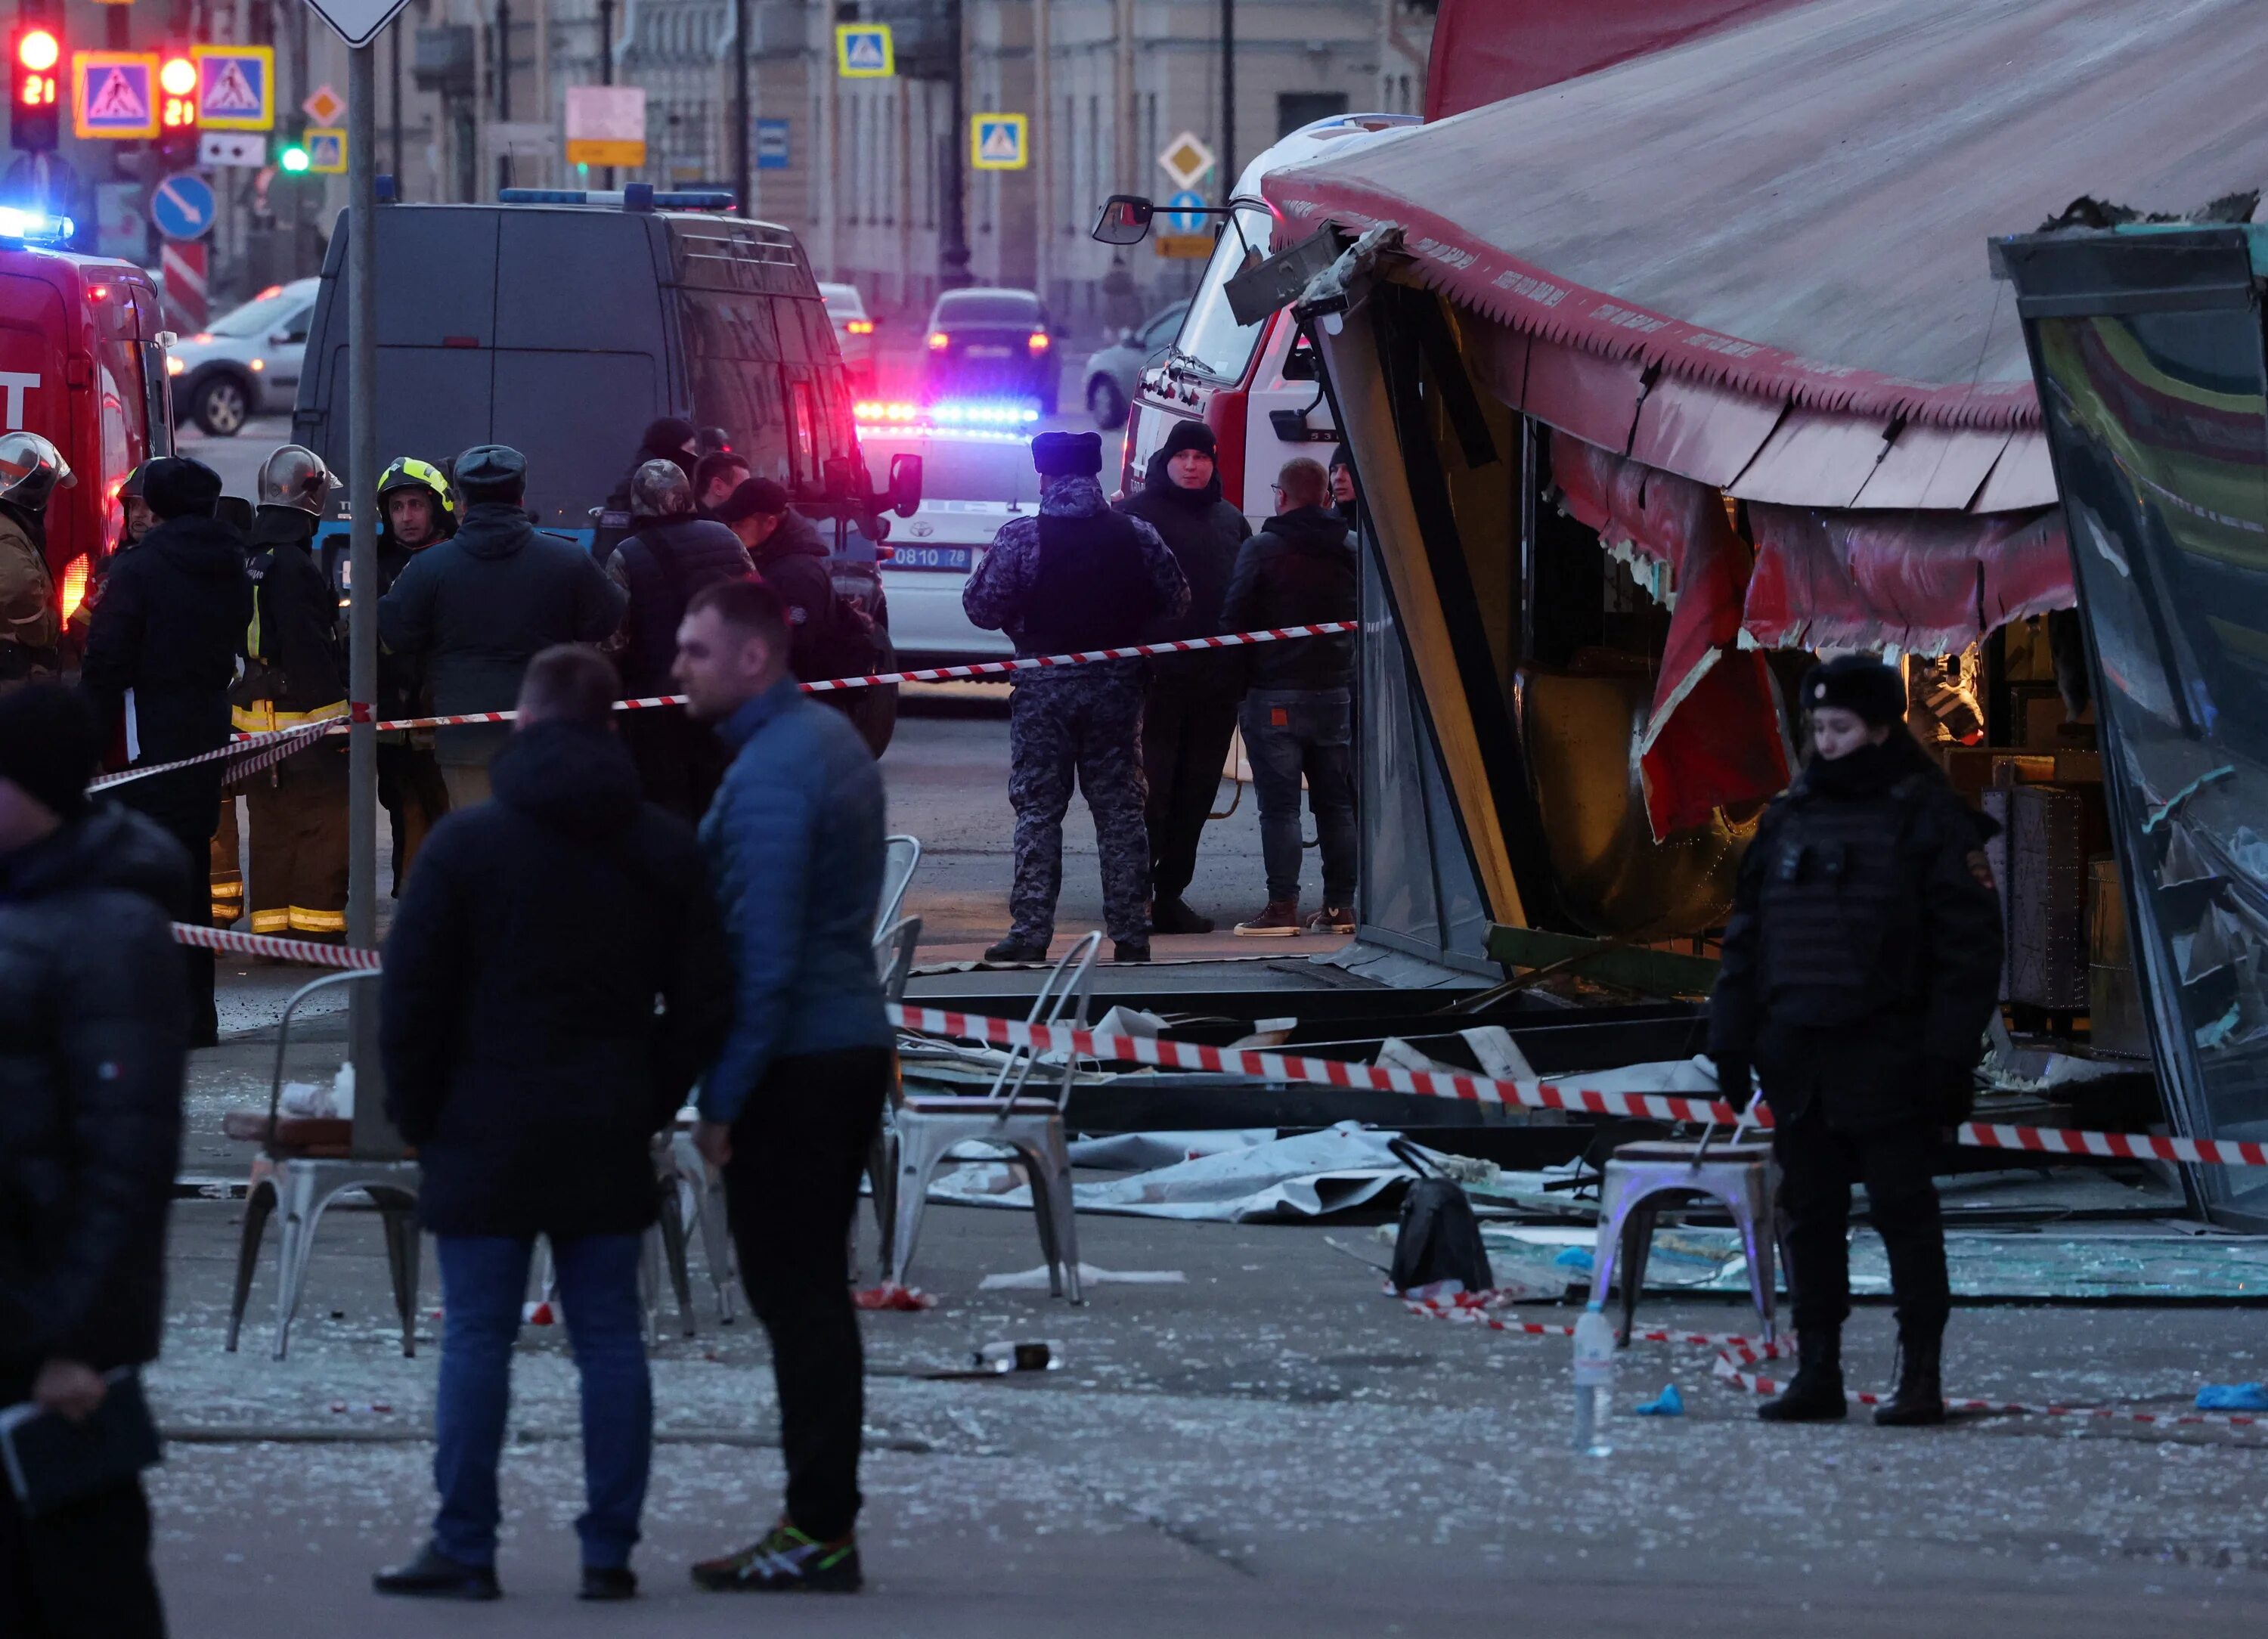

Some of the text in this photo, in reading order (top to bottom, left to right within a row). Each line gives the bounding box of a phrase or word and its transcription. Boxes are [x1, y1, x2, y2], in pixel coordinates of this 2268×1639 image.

[23, 75, 55, 104] 21
[164, 98, 194, 126] 21
[881, 548, 965, 566] 0810 78
